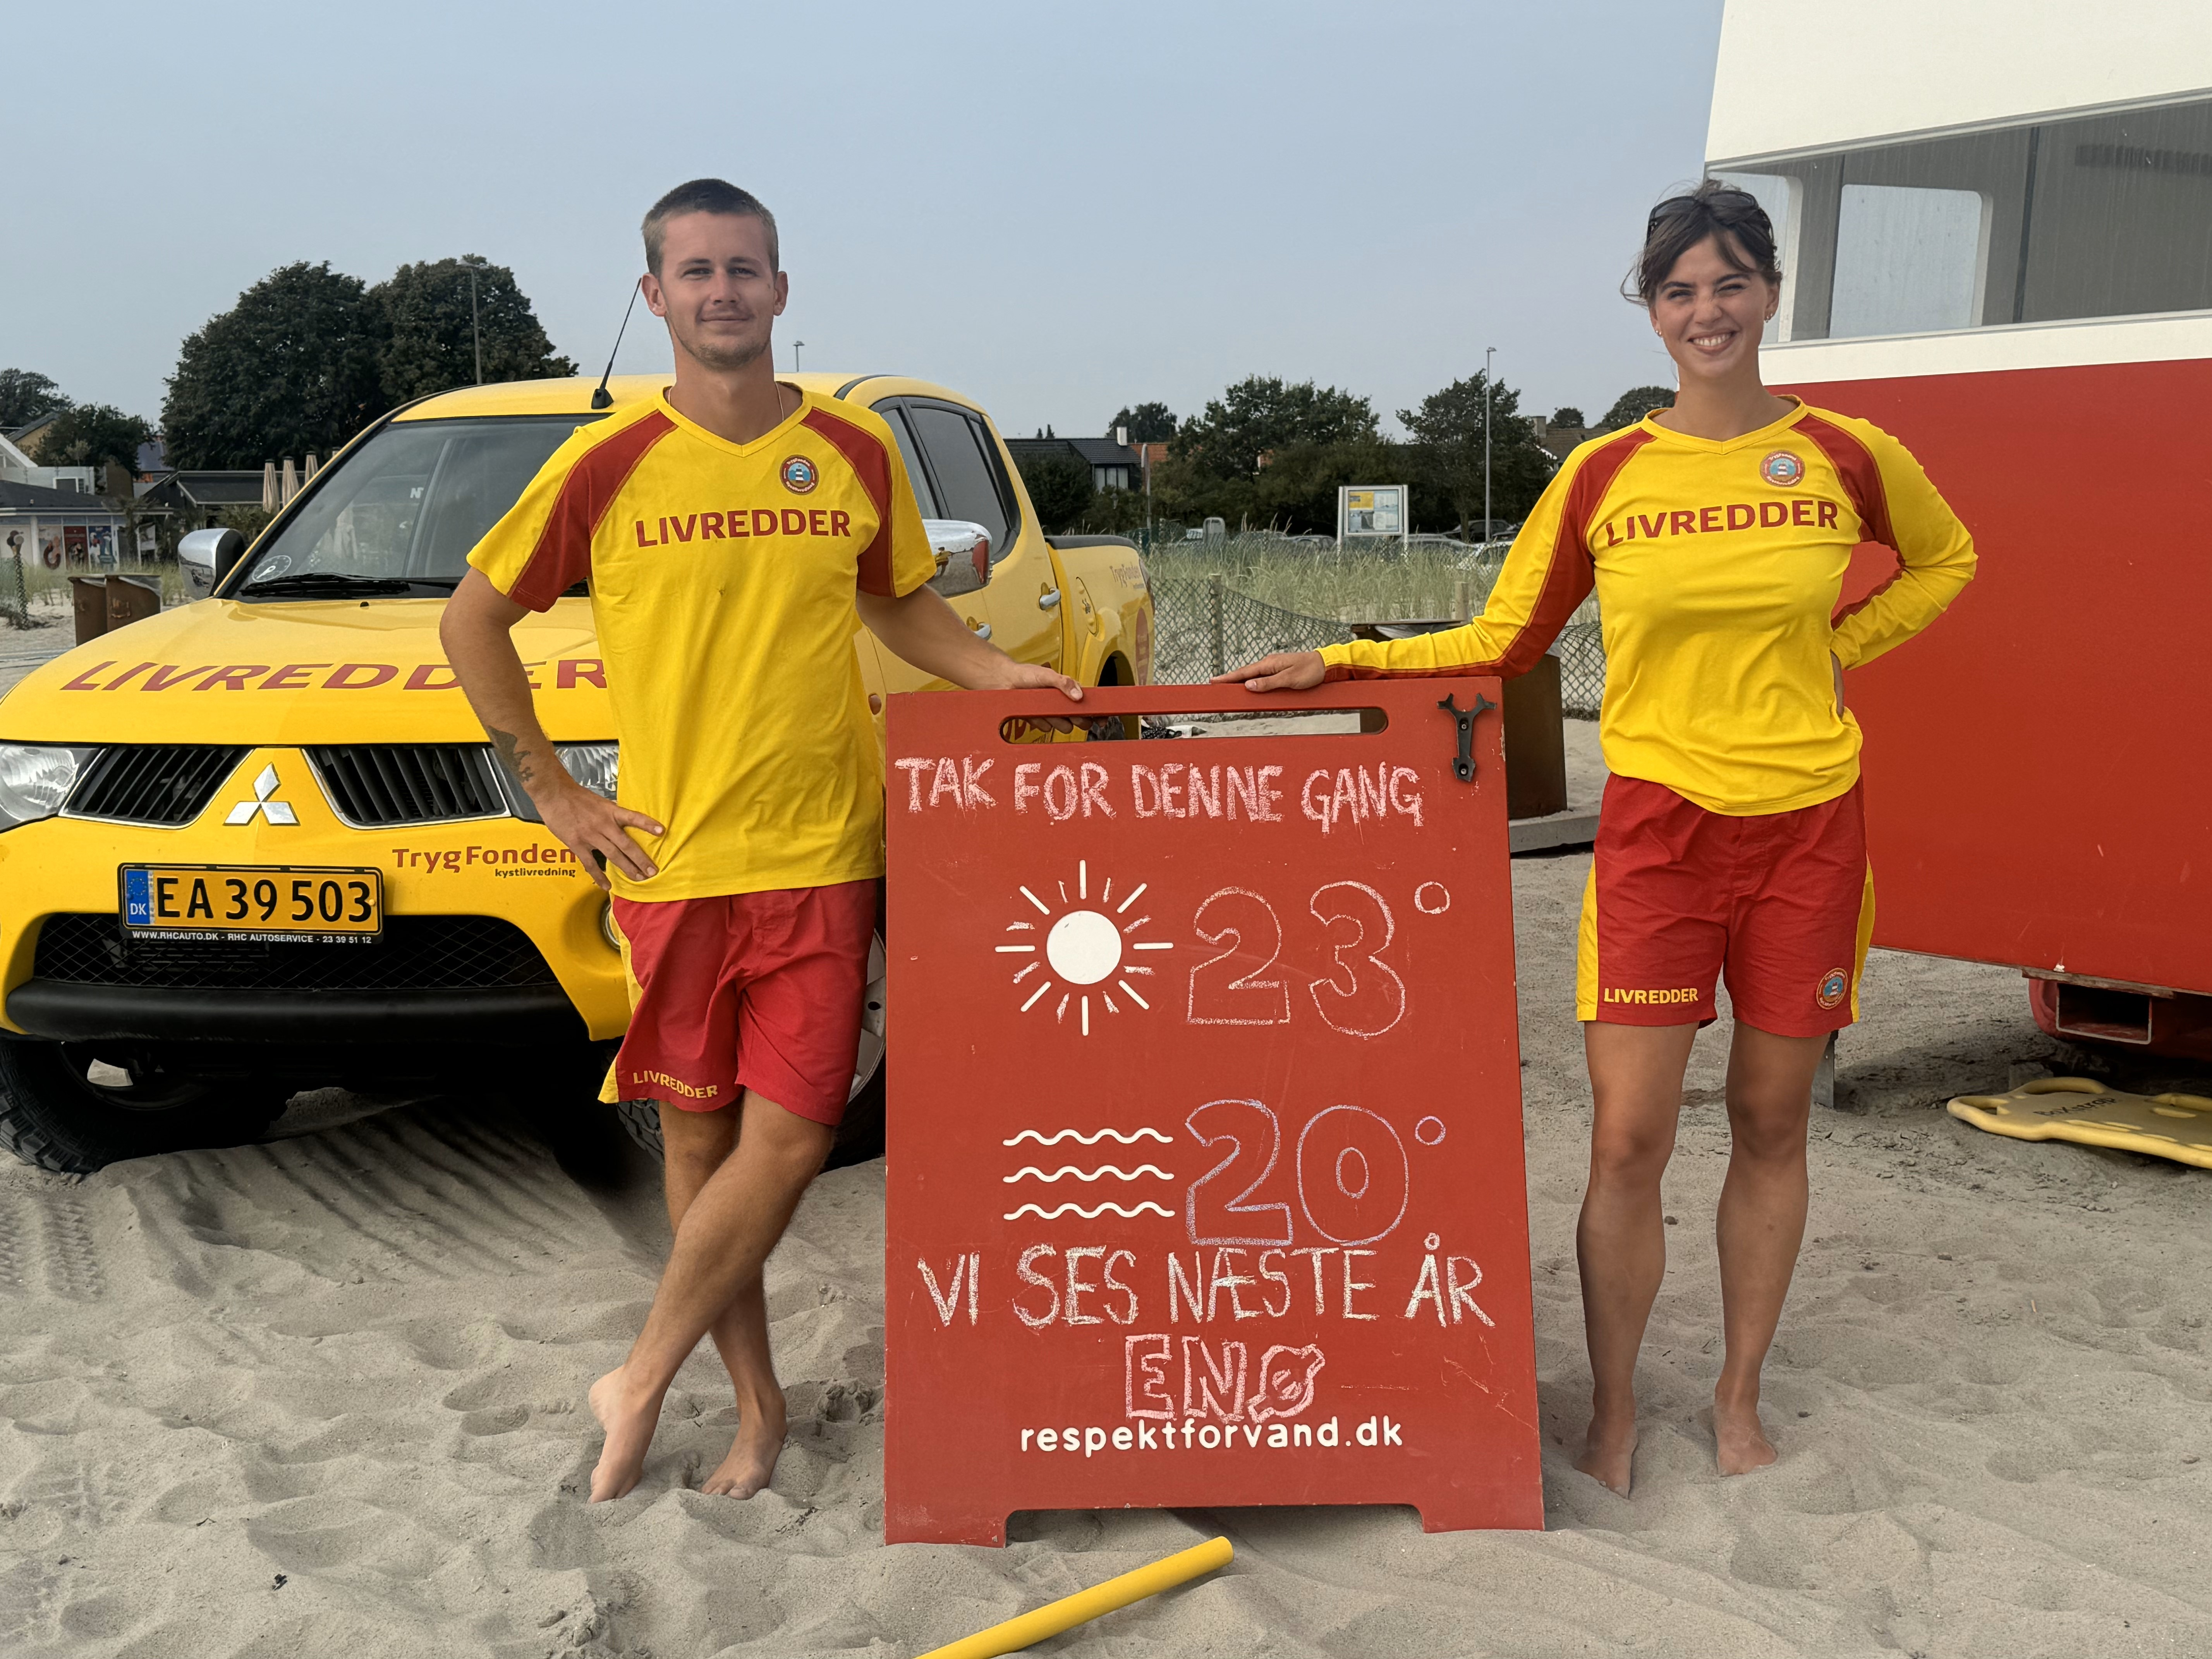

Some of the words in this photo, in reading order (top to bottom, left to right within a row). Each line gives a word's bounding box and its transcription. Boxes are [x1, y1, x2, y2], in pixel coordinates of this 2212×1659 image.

[635, 508, 851, 547] LIVREDDER
[1605, 500, 1838, 547] LIVREDDER
[895, 755, 998, 814] TAK
[1014, 762, 1117, 821] FOR
[1131, 763, 1284, 823] DENNE
[1300, 761, 1424, 836] GANG
[392, 843, 577, 874] TrygFonden
[495, 868, 576, 878] kystlivredning
[130, 903, 147, 916] DK
[156, 877, 214, 919] EA
[225, 879, 278, 922] 39
[292, 880, 372, 922] 503
[132, 930, 219, 941] WWW.RHCAUTO.DK
[250, 934, 314, 943] AUTOSERVICE
[1604, 988, 1699, 1005] LIVREDDER
[633, 1070, 718, 1099] LIVREDDER
[916, 1251, 980, 1328] VI
[1013, 1243, 1139, 1331] SES
[1167, 1247, 1379, 1324] NÆSTE
[1403, 1231, 1496, 1328] ÅR
[1021, 1415, 1403, 1458] respektforvand.dk
